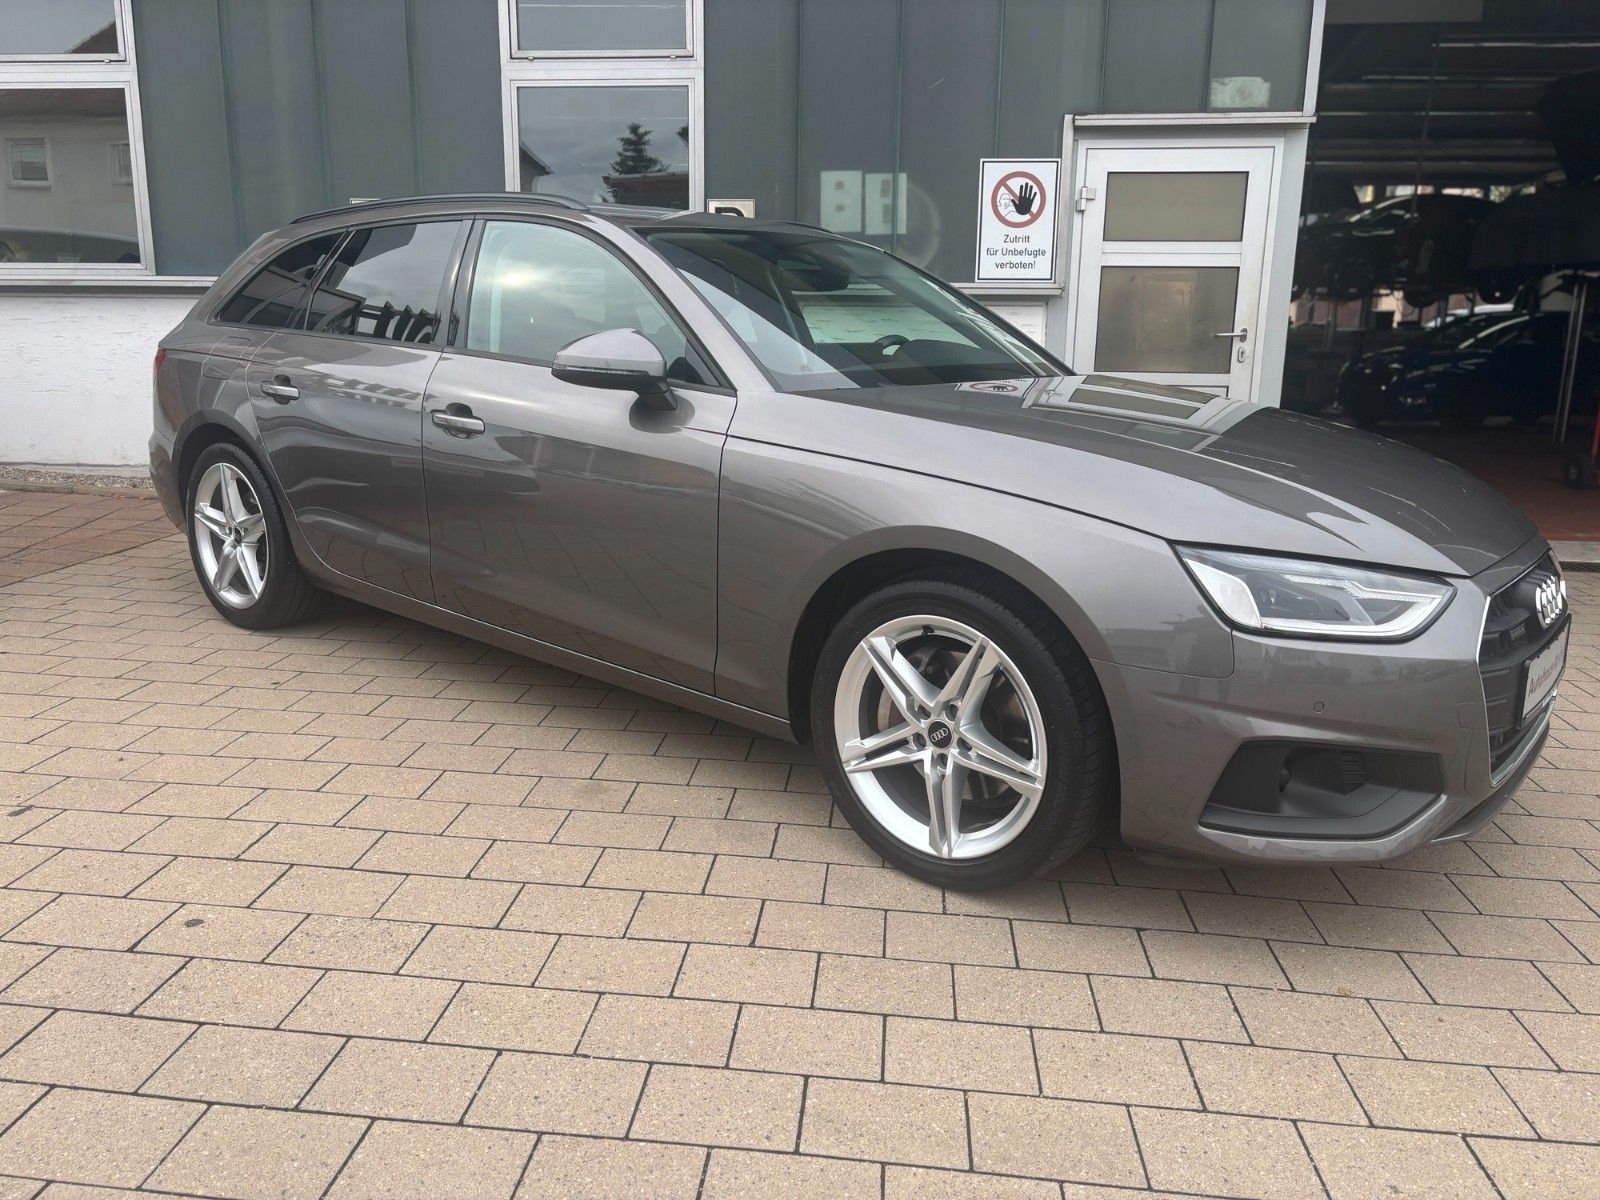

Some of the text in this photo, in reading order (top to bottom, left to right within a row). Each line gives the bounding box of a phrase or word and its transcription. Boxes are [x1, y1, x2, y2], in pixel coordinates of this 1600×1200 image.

[1003, 235, 1030, 243] Zutritt
[986, 248, 1046, 258] für Unbefugte
[995, 261, 1036, 269] verboten!
